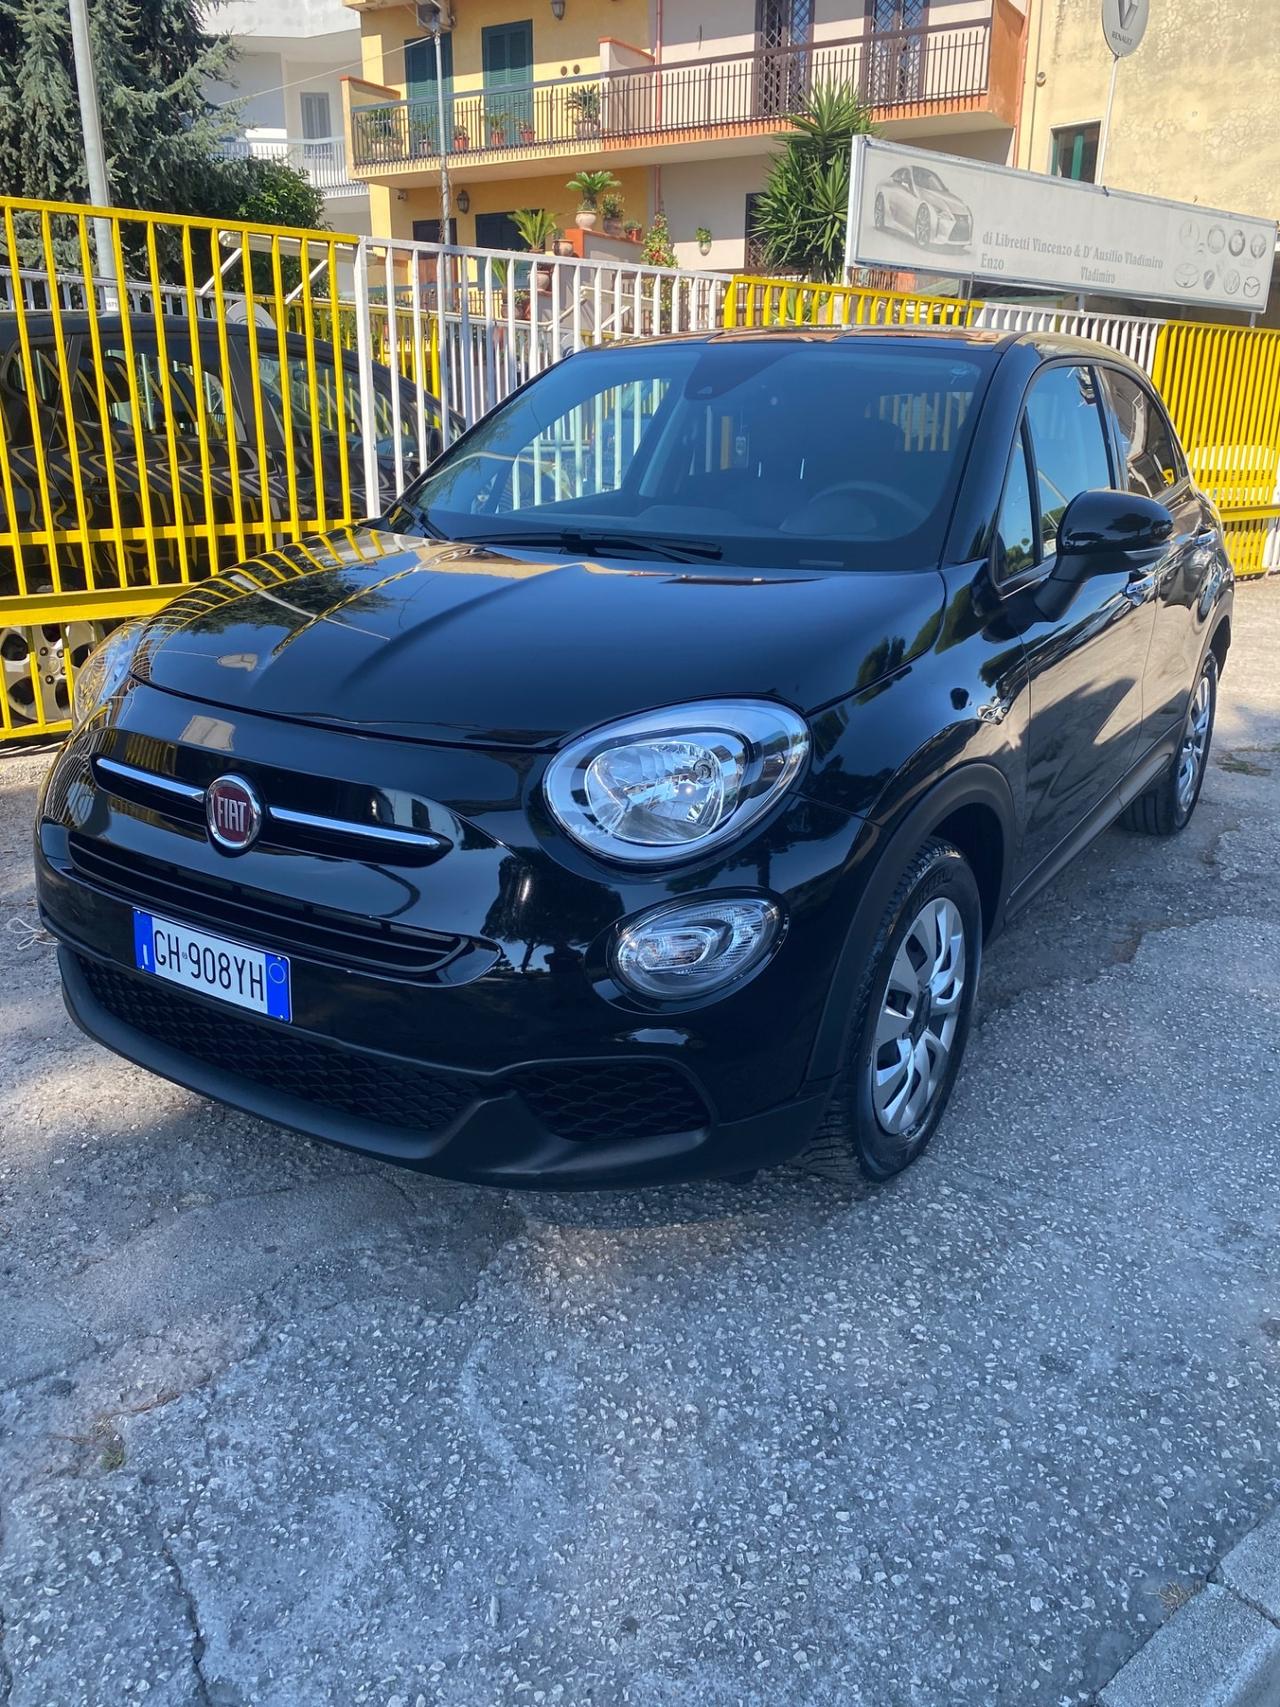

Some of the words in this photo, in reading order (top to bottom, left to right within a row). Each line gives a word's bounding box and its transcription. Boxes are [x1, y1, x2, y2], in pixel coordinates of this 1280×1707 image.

[980, 253, 1005, 271] Enzo
[982, 231, 992, 246] di
[995, 232, 1030, 251] Libretti
[1033, 237, 1072, 257] Vincenzo
[1074, 245, 1081, 257] &
[1125, 251, 1164, 270] Vladimiro
[1080, 266, 1116, 284] Vladimiro
[217, 796, 247, 832] FIAT
